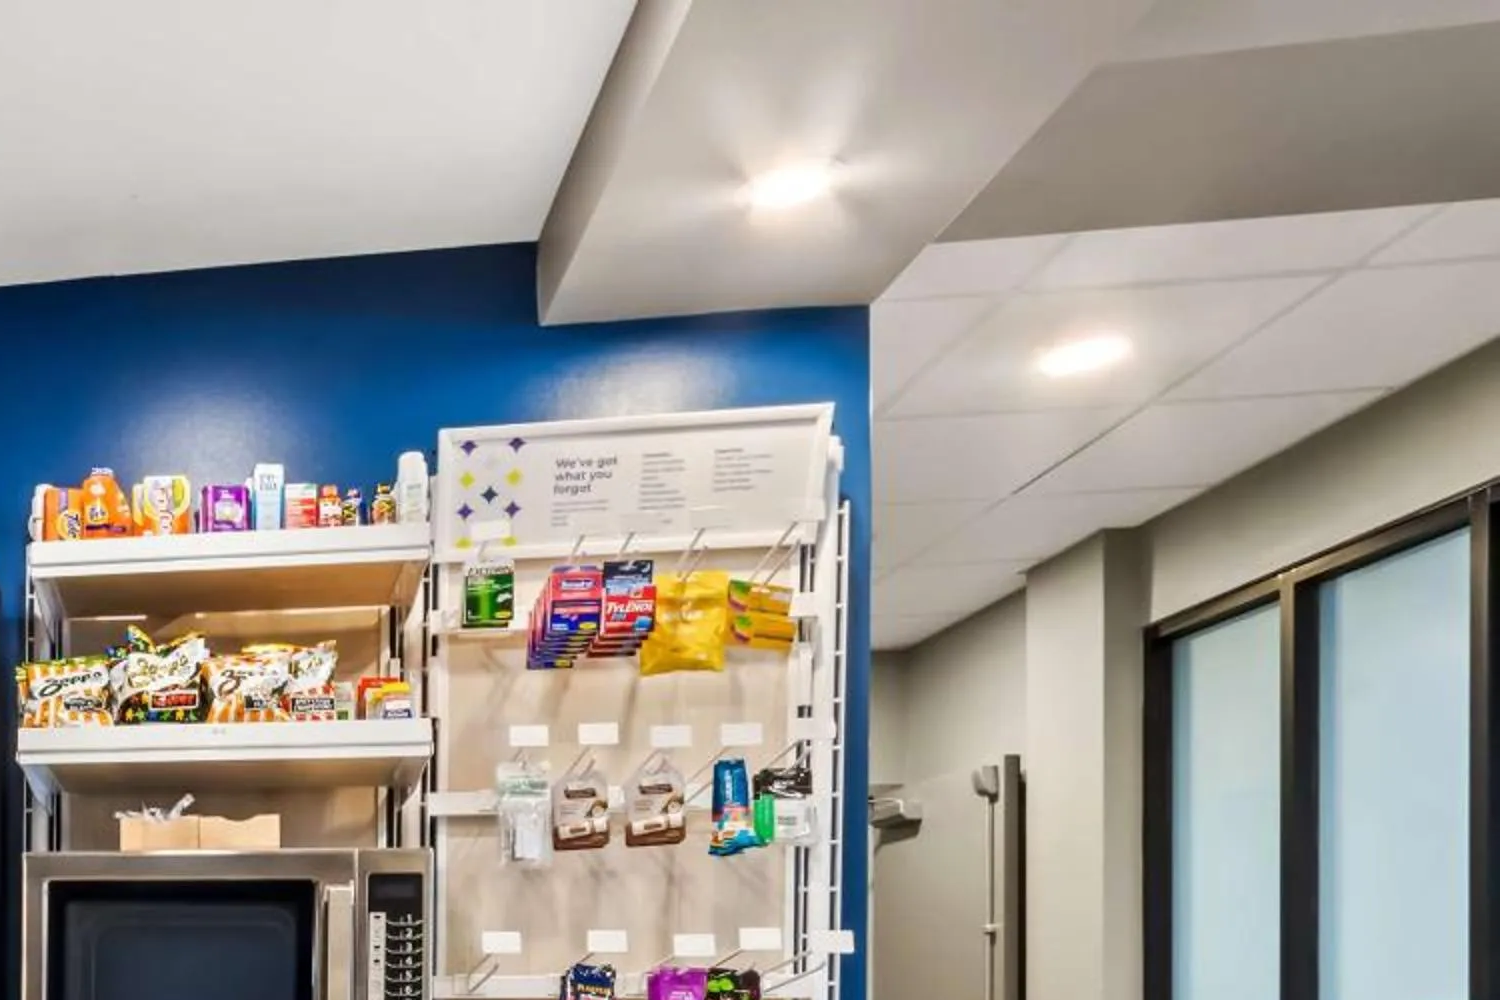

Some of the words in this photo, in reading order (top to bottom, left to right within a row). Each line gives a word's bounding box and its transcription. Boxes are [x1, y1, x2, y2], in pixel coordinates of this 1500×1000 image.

[556, 457, 593, 469] We've
[597, 456, 618, 469] got
[554, 471, 587, 481] what
[589, 471, 613, 482] you
[553, 484, 592, 495] forgot
